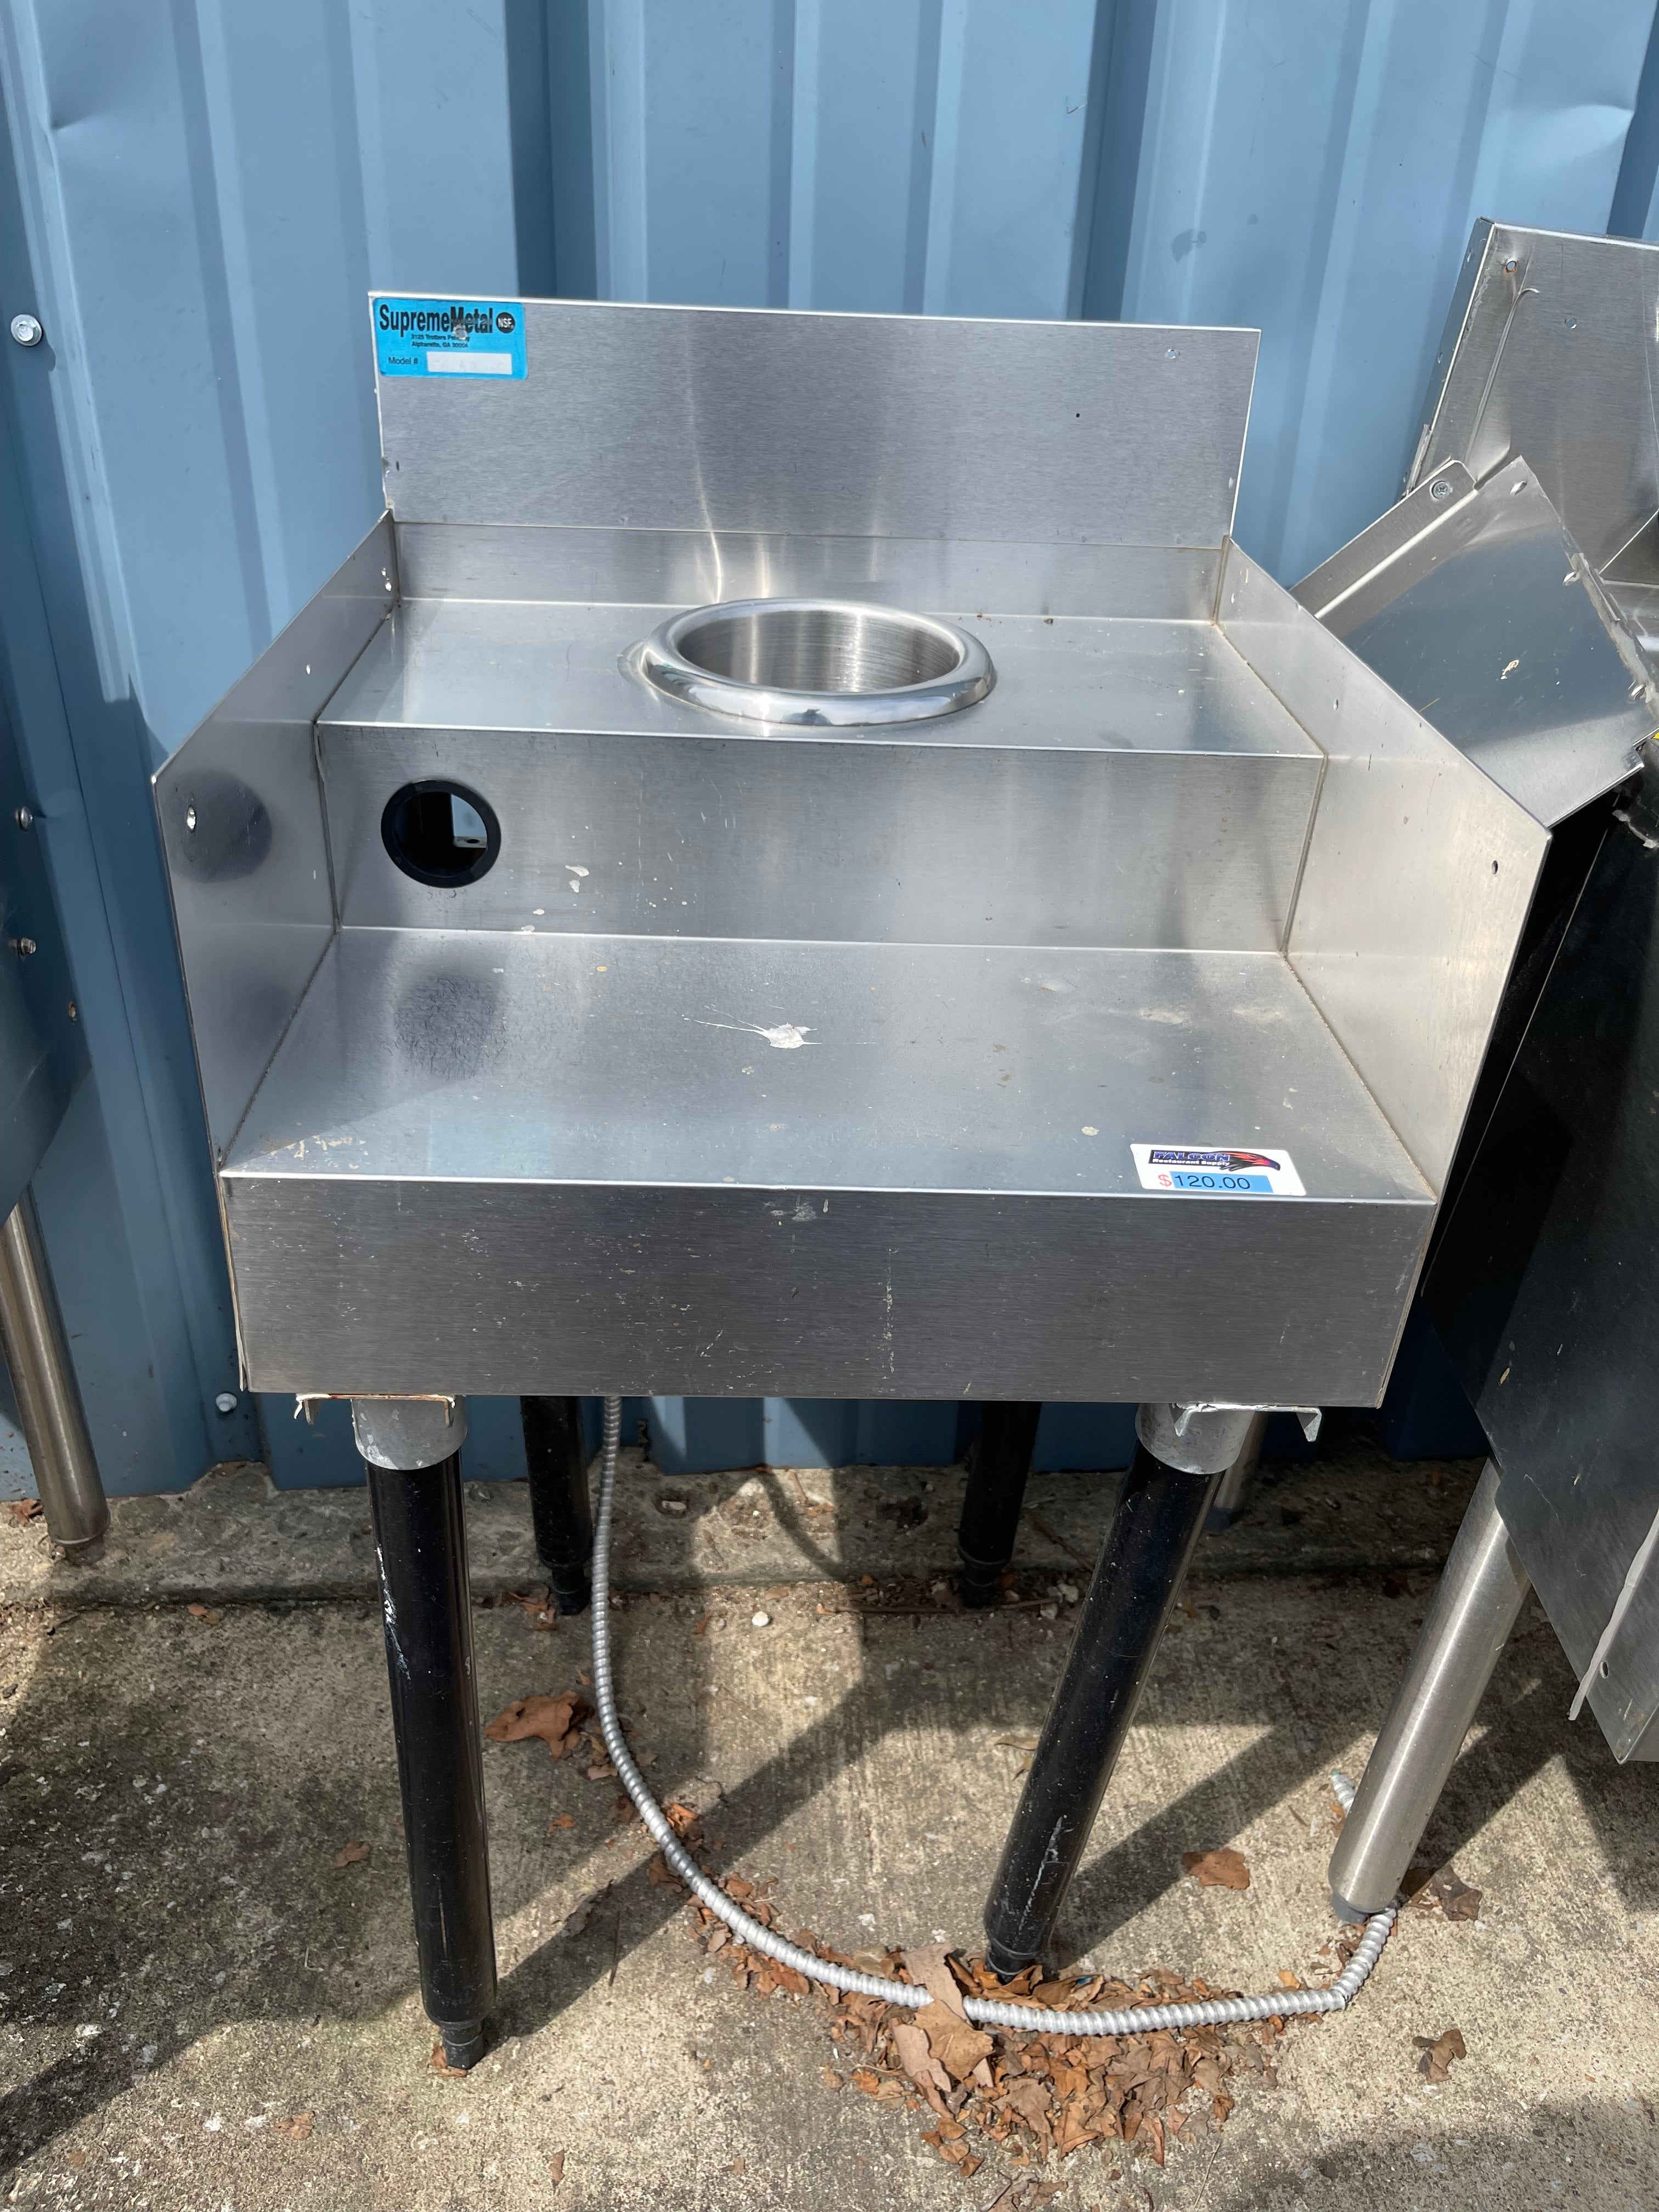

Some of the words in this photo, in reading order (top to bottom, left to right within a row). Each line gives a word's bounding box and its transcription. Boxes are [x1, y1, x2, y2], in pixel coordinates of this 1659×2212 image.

[379, 304, 493, 337] SupremeMetal
[388, 357, 411, 365] Model
[1153, 1151, 1231, 1162] FALCON
